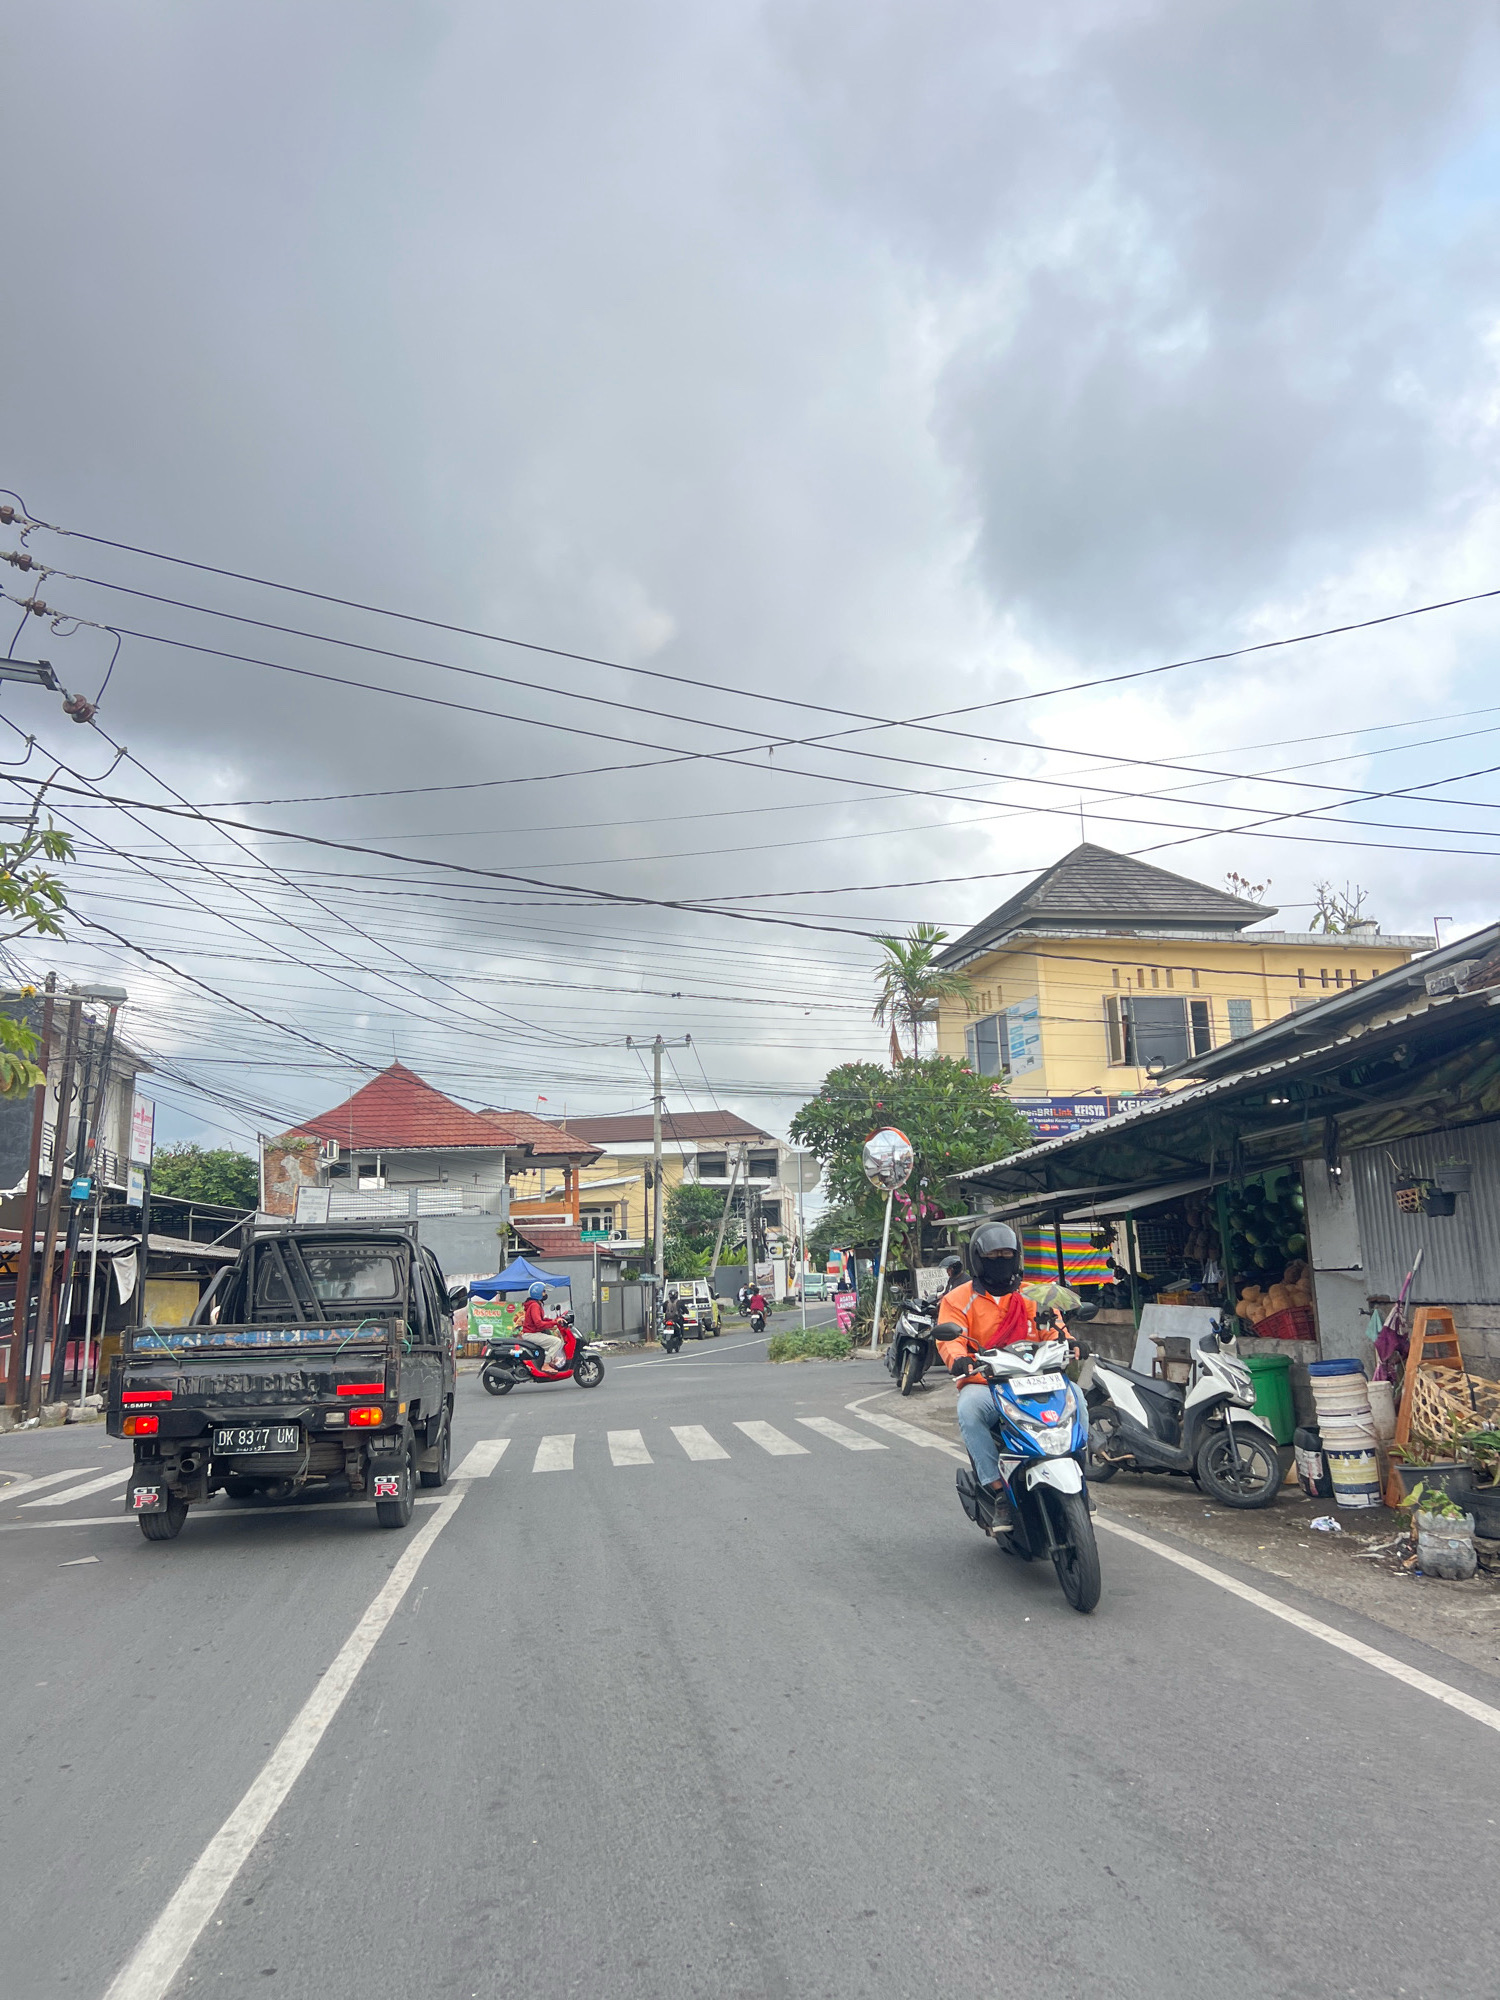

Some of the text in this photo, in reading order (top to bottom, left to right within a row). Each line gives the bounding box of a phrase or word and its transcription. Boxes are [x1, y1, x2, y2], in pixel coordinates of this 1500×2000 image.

[1074, 1104, 1106, 1117] KEISYA
[218, 1428, 295, 1446] DK 8377 UM
[374, 1475, 400, 1483] GT
[133, 1485, 161, 1495] GT
[374, 1482, 399, 1497] R
